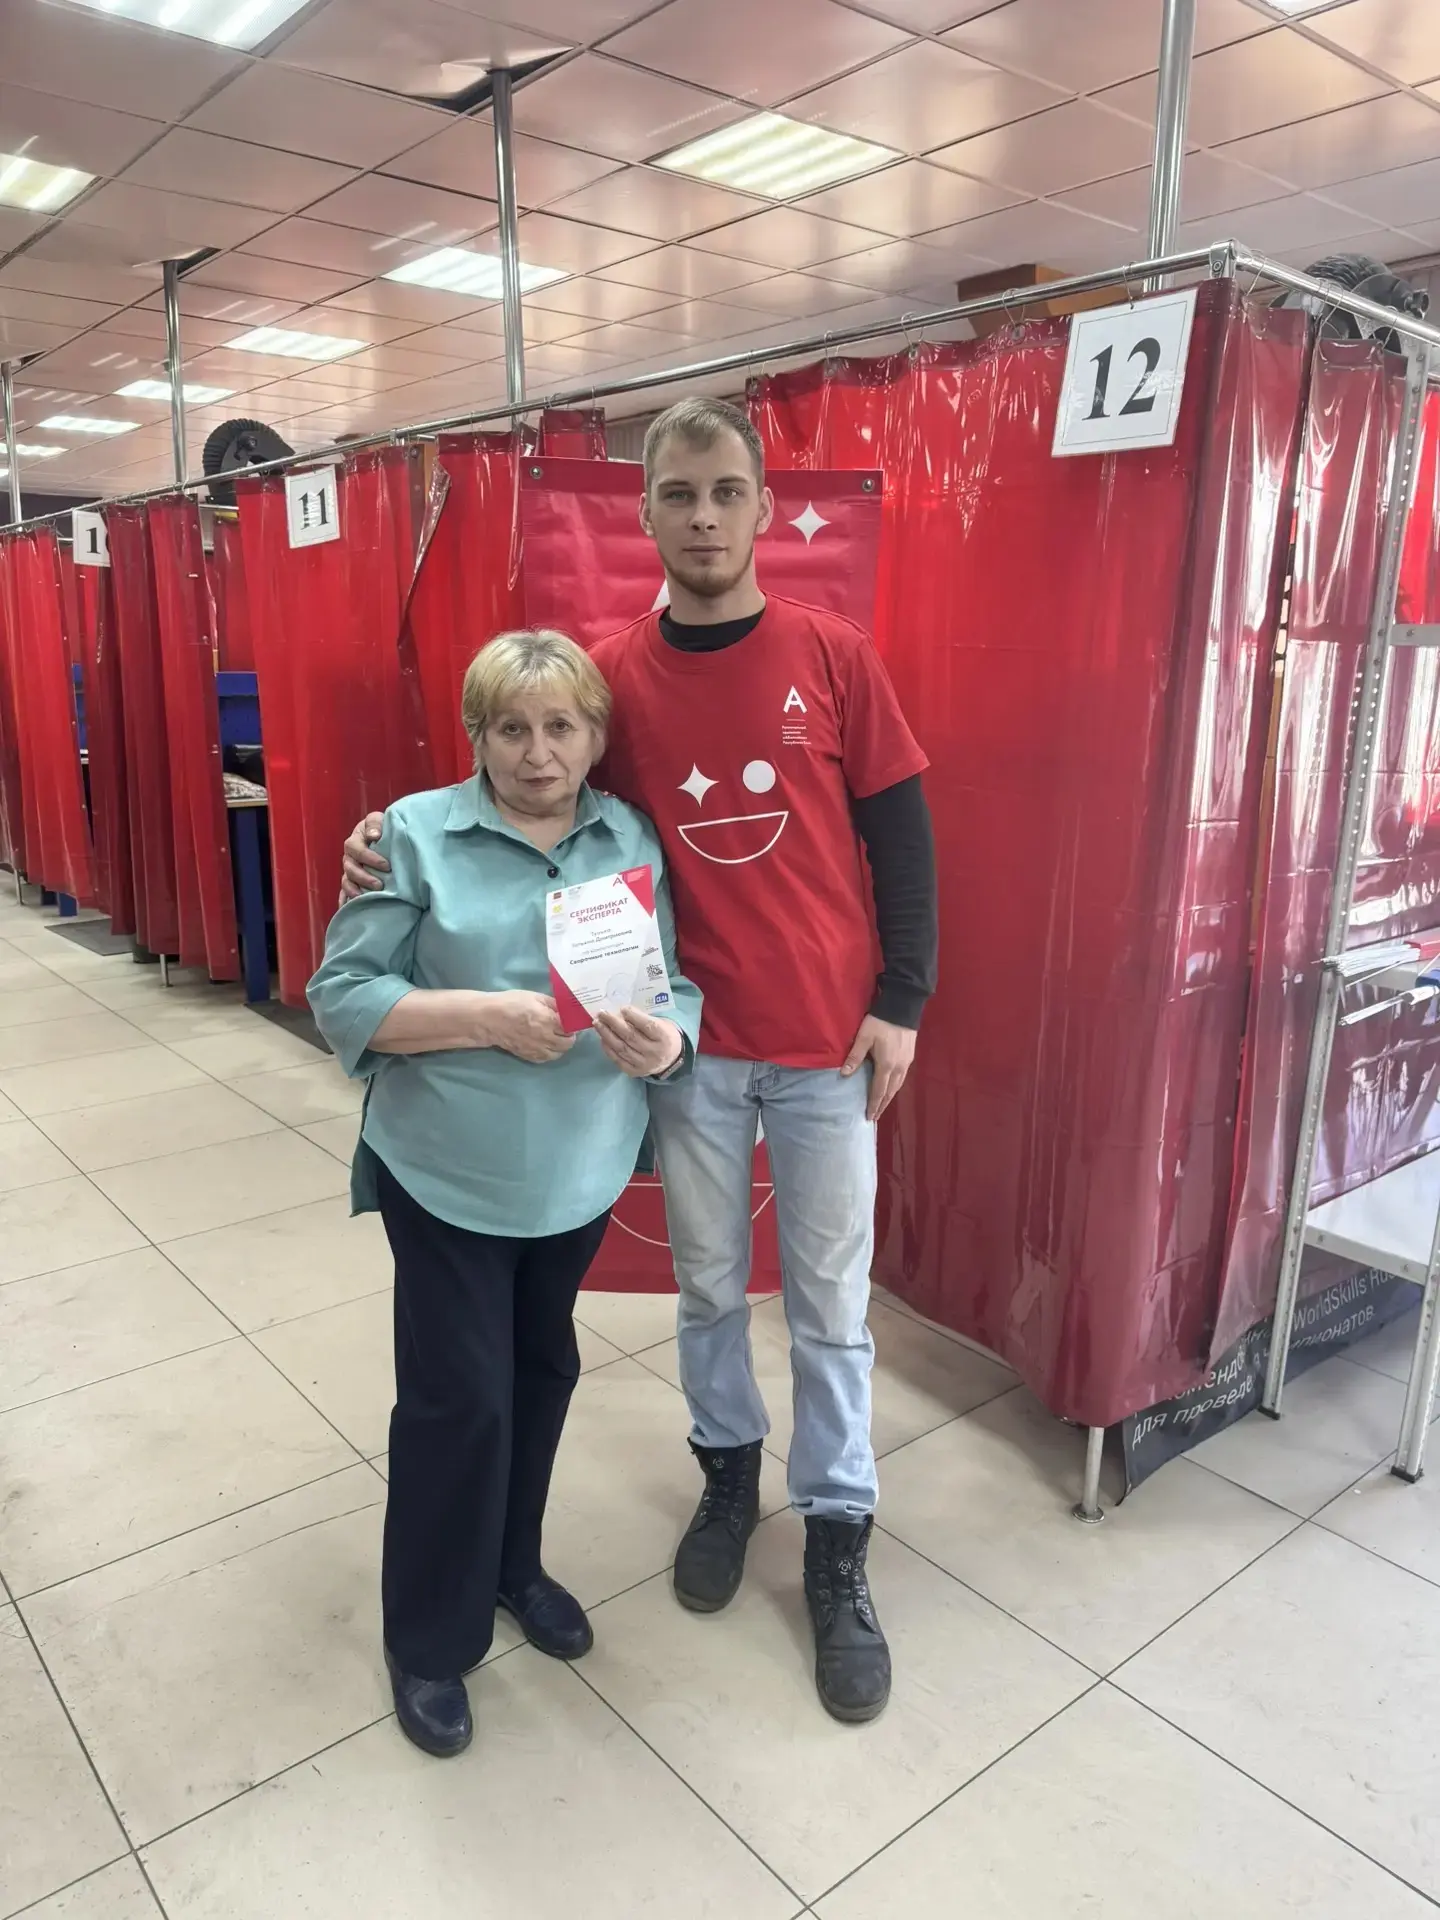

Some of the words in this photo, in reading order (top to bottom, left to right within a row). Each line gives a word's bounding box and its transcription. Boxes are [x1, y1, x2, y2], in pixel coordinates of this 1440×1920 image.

[1081, 337, 1161, 421] 12
[299, 487, 330, 529] 11
[86, 527, 108, 554] 1
[569, 897, 629, 918] СЕРТИФИКАТ
[577, 907, 622, 924] ЭКСПЕРТА
[569, 954, 603, 966] Сварочные
[604, 945, 639, 957] технологии
[1292, 1275, 1367, 1332] WorldSkills
[1370, 1267, 1395, 1290] Ru
[1132, 1412, 1168, 1450] для
